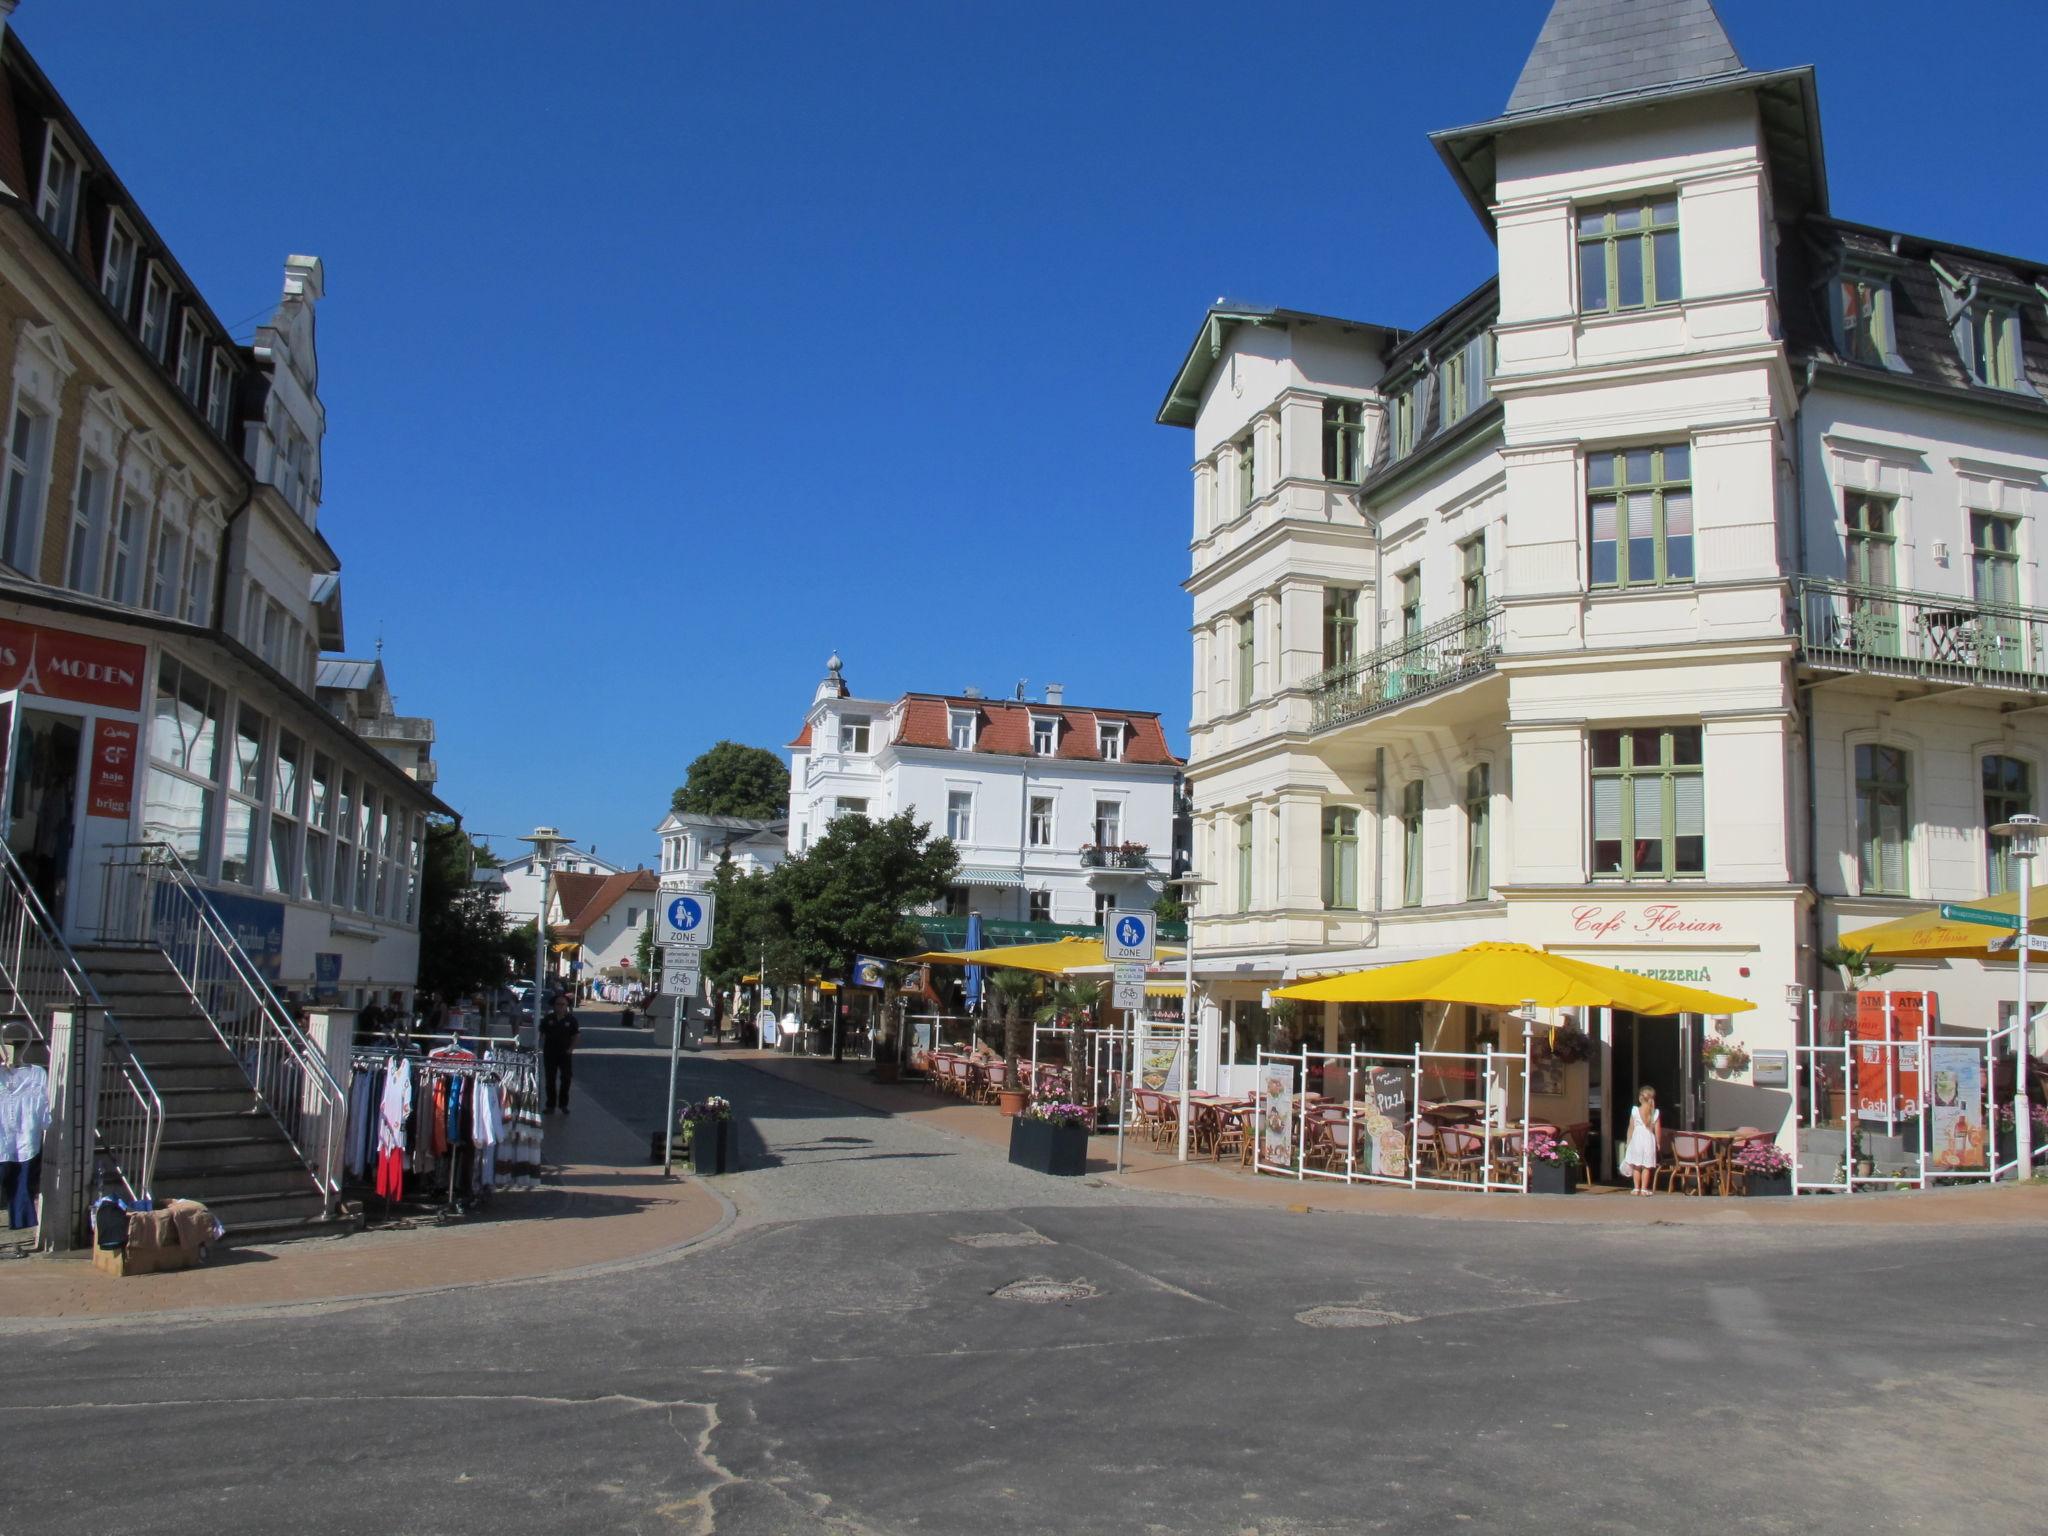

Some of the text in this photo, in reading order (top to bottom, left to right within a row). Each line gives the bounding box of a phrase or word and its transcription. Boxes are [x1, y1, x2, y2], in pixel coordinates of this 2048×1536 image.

[47, 656, 135, 687] MODEN
[1634, 904, 1723, 932] Florian
[670, 932, 697, 942] ZONE
[1119, 948, 1141, 957] ZONE
[674, 985, 686, 993] frei
[1861, 996, 1881, 1006] ATM
[1898, 997, 1922, 1008] ATM
[1377, 1089, 1406, 1113] PIZZA
[1860, 1097, 1887, 1112] Cash
